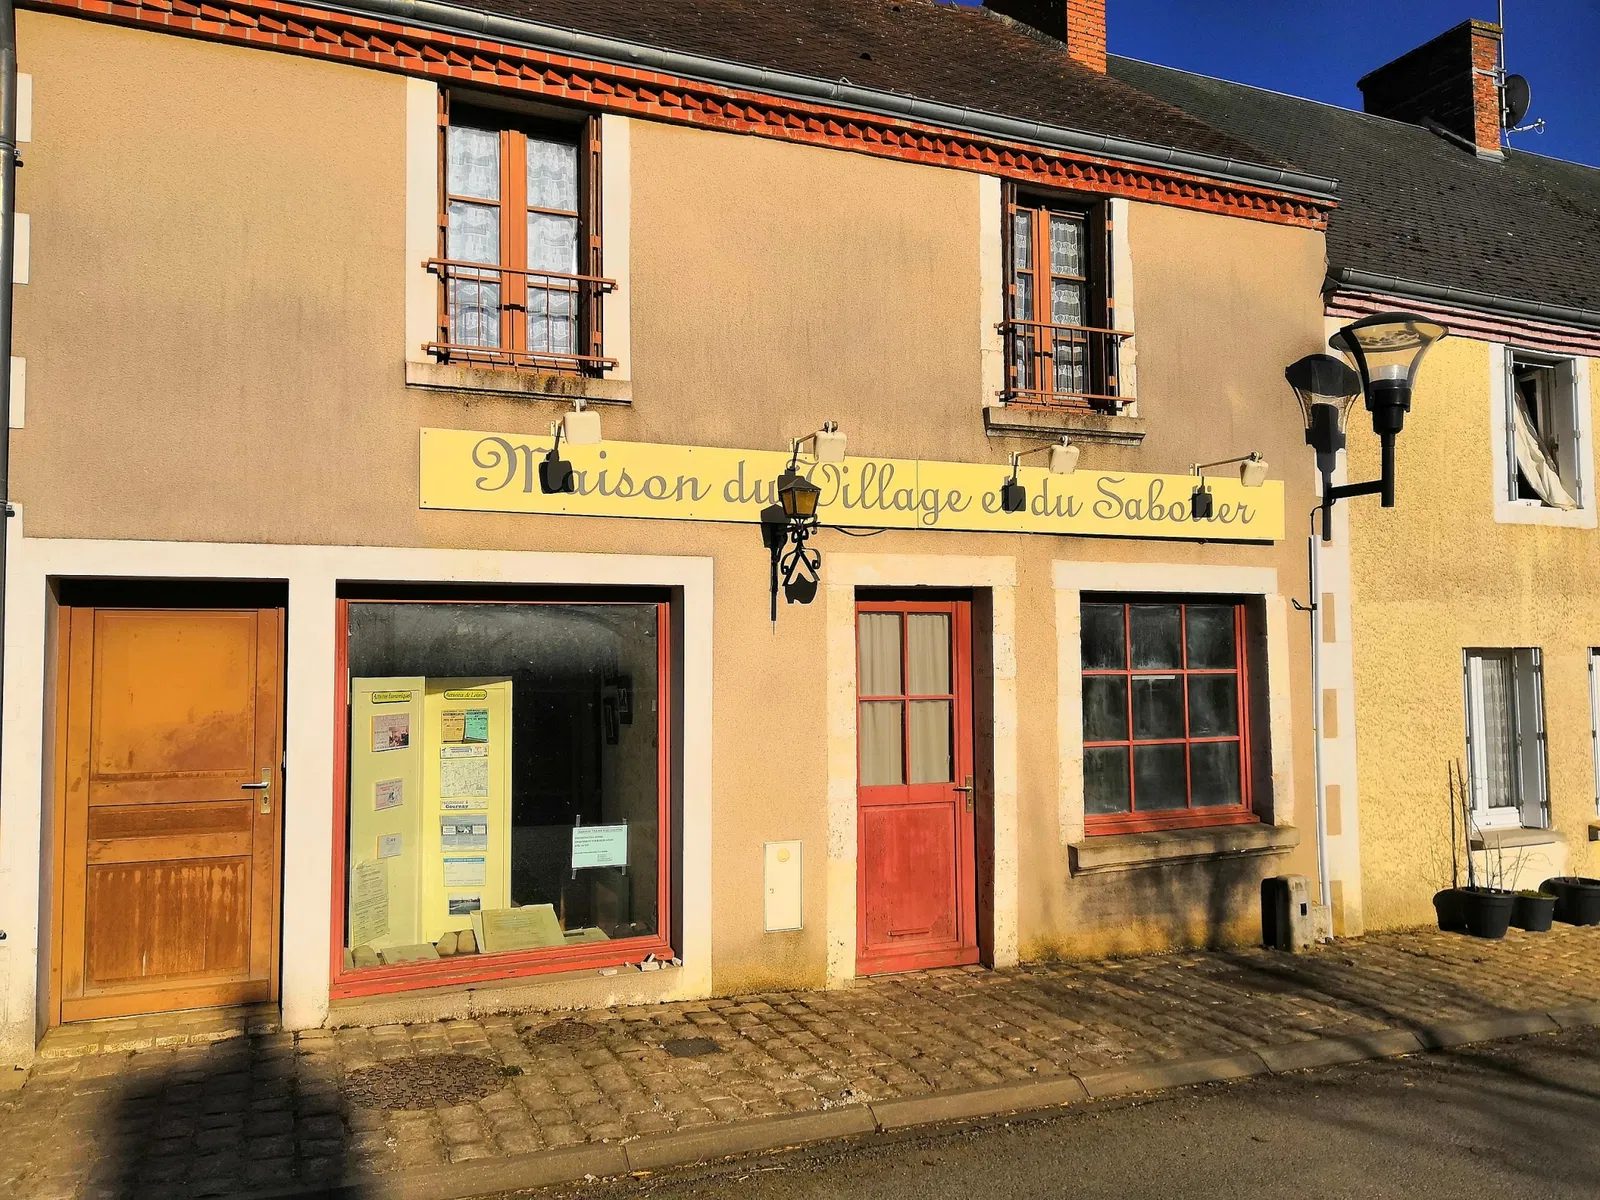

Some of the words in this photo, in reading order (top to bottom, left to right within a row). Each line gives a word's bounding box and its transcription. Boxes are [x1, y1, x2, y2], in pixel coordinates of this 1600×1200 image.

[472, 436, 712, 502] Maison
[724, 460, 779, 504] du
[786, 459, 972, 525] Village
[1031, 477, 1083, 517] du
